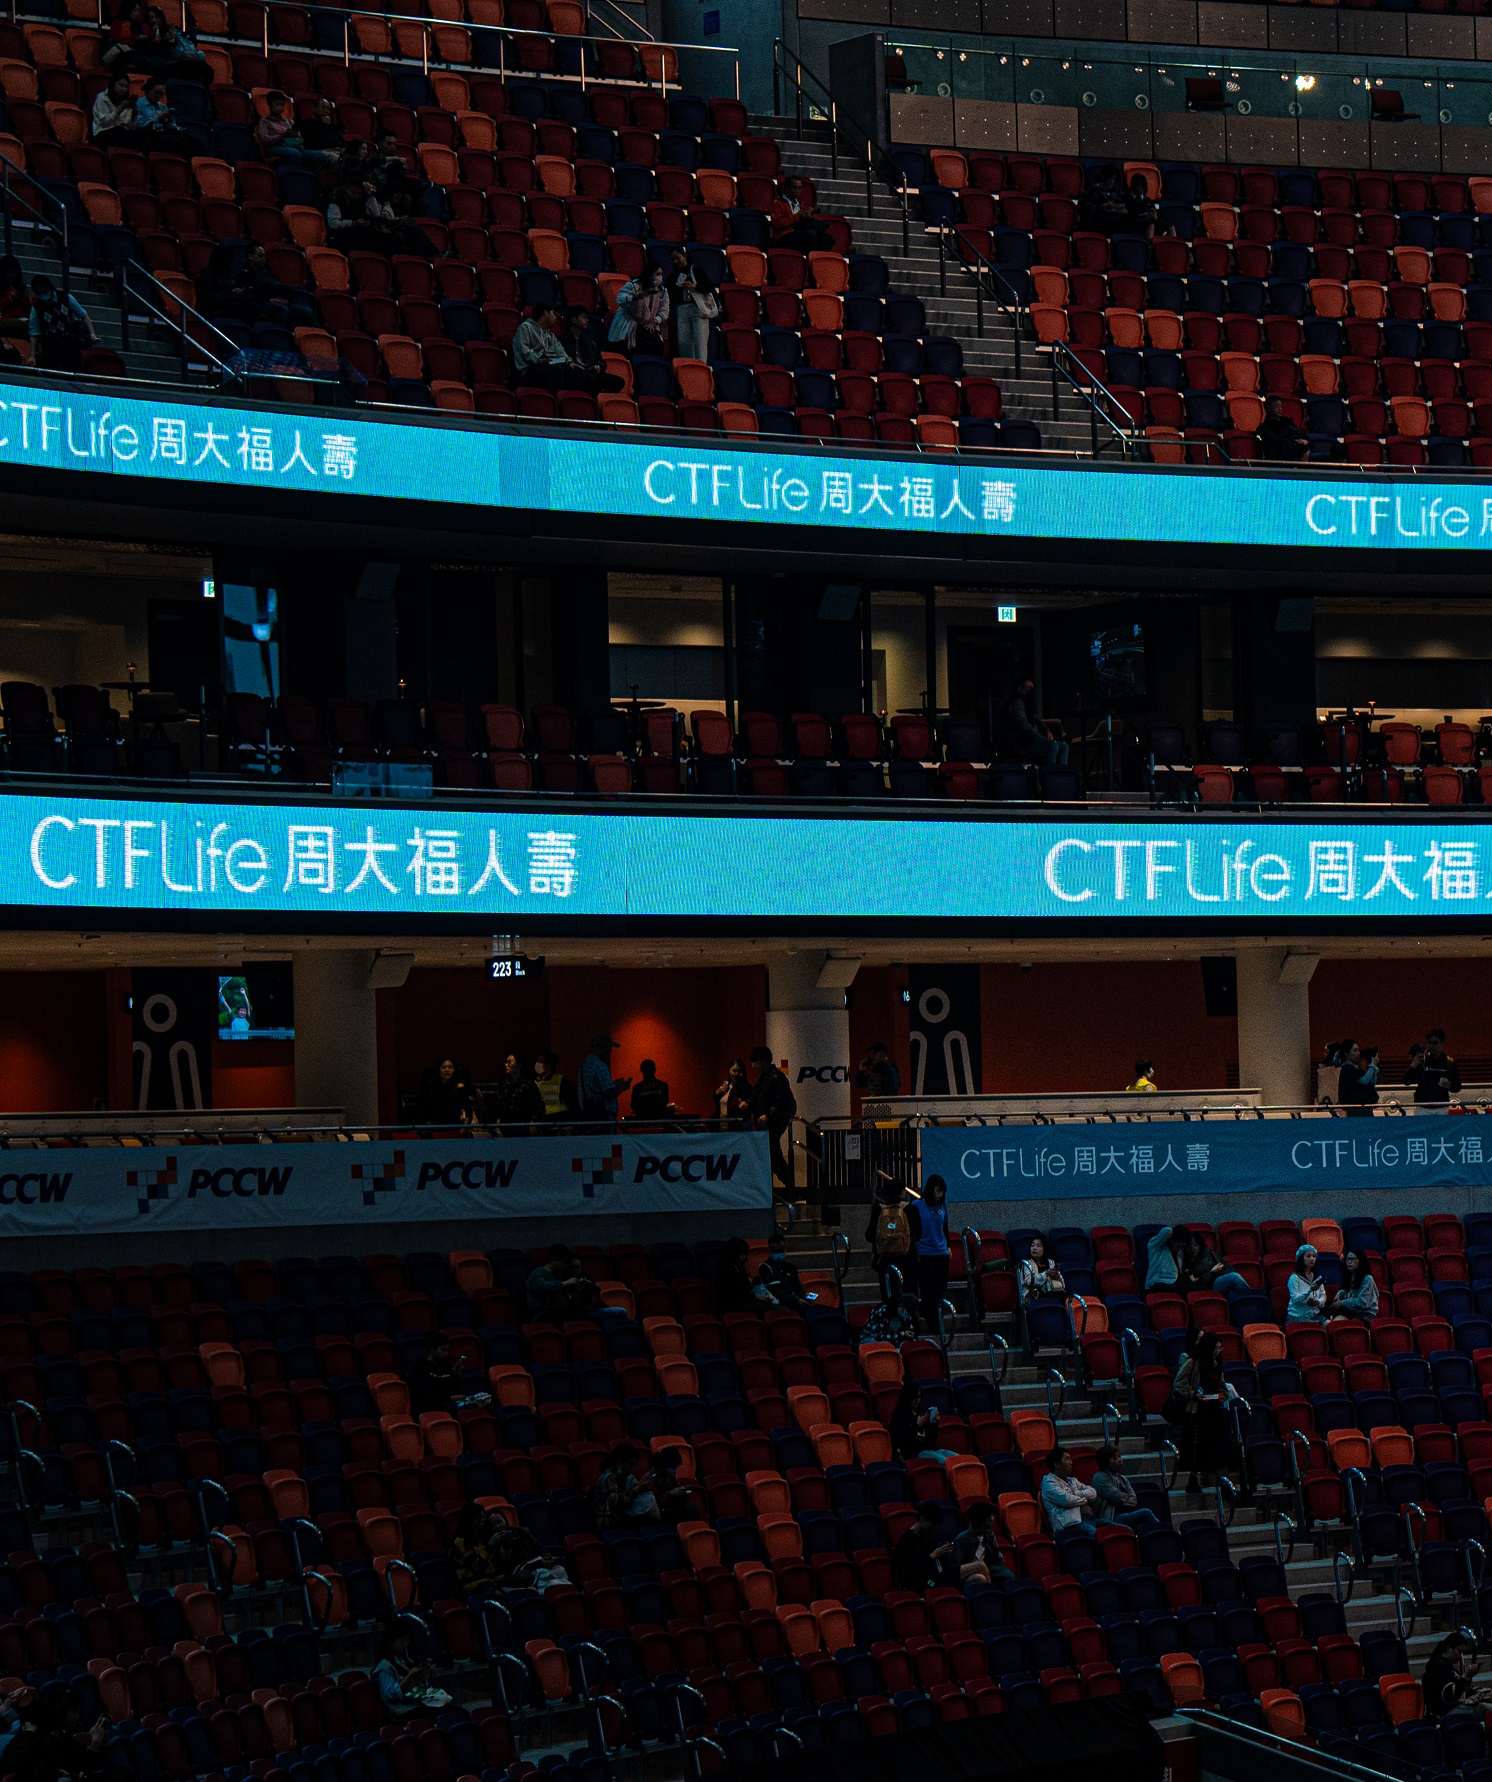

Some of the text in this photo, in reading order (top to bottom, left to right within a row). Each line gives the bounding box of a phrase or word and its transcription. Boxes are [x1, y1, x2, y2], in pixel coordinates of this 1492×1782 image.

[153, 418, 358, 478] 周大福人壽
[645, 461, 1016, 521] CTFLife 周大福人壽
[1306, 495, 1469, 536] CTFLife
[31, 816, 580, 897] CTFLife 周大福人壽
[1045, 839, 1290, 901] CTFLife
[493, 961, 512, 977] 223
[634, 1155, 740, 1183] PCCW
[961, 1143, 1209, 1178] CTFLife 周大福人壽
[1292, 1139, 1399, 1168] CTFLife
[188, 1167, 292, 1197] PCCW
[417, 1160, 517, 1190] PCCW
